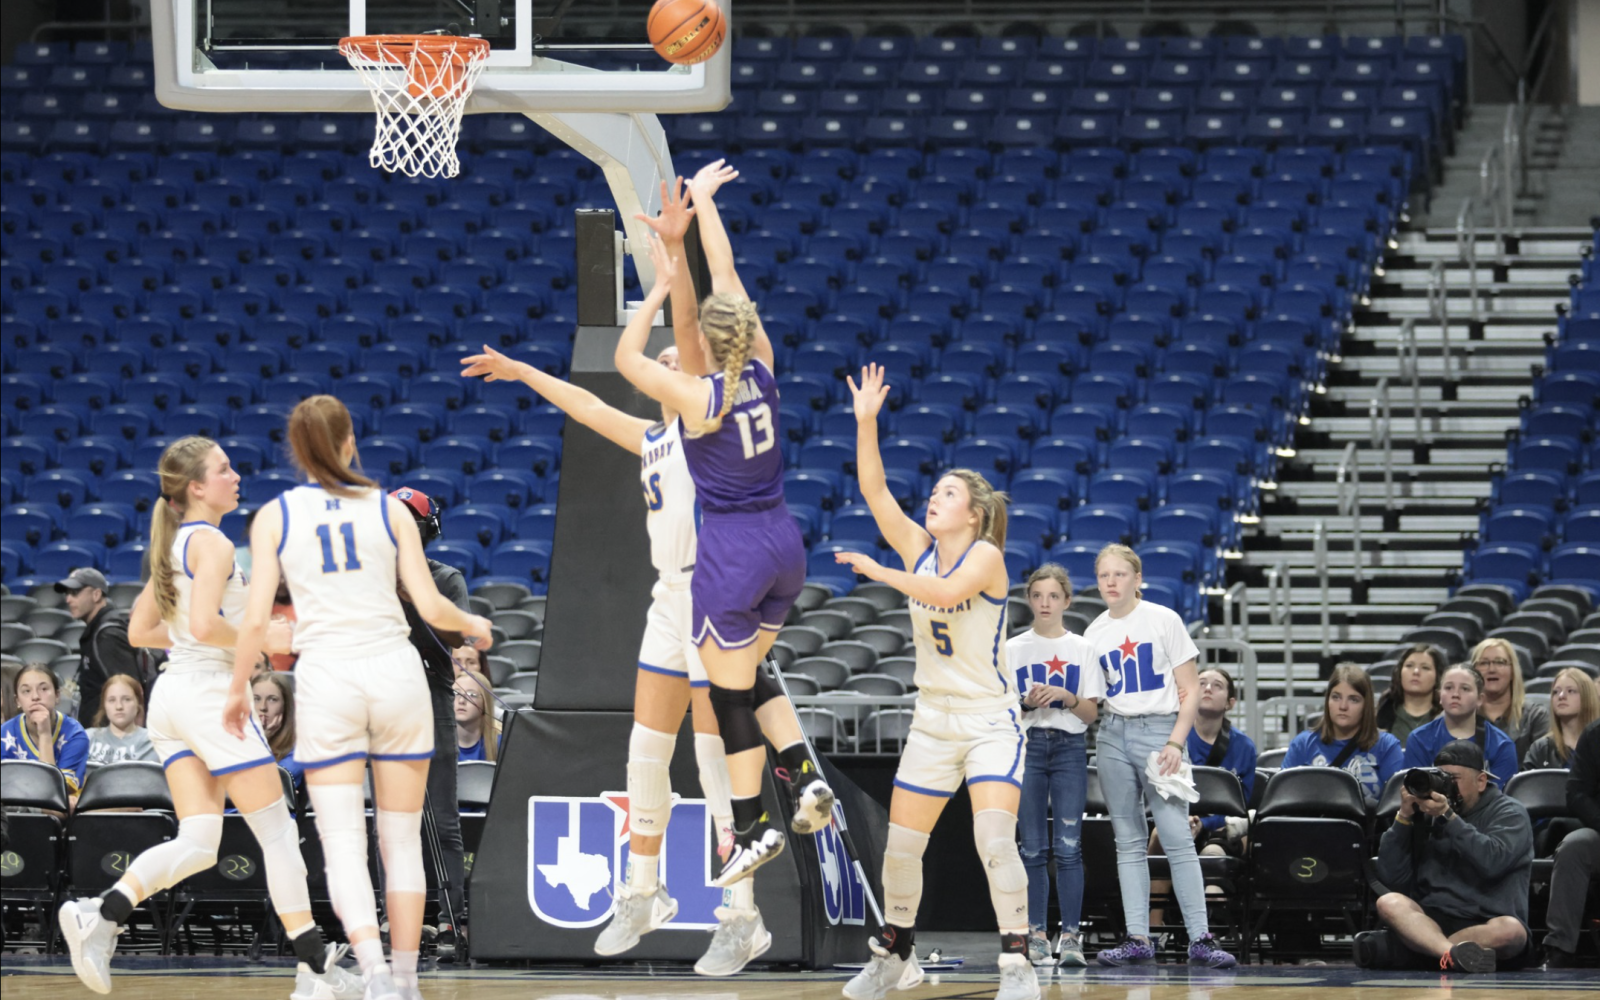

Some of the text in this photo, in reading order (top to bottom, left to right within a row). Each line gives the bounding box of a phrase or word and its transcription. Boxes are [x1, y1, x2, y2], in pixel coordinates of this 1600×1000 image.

[734, 402, 775, 460] 13
[325, 498, 341, 511] H
[315, 521, 362, 574] 11
[930, 619, 955, 659] 5
[1100, 637, 1166, 698] UIL
[110, 853, 131, 872] 21
[226, 855, 250, 878] 22
[1297, 857, 1317, 877] 3
